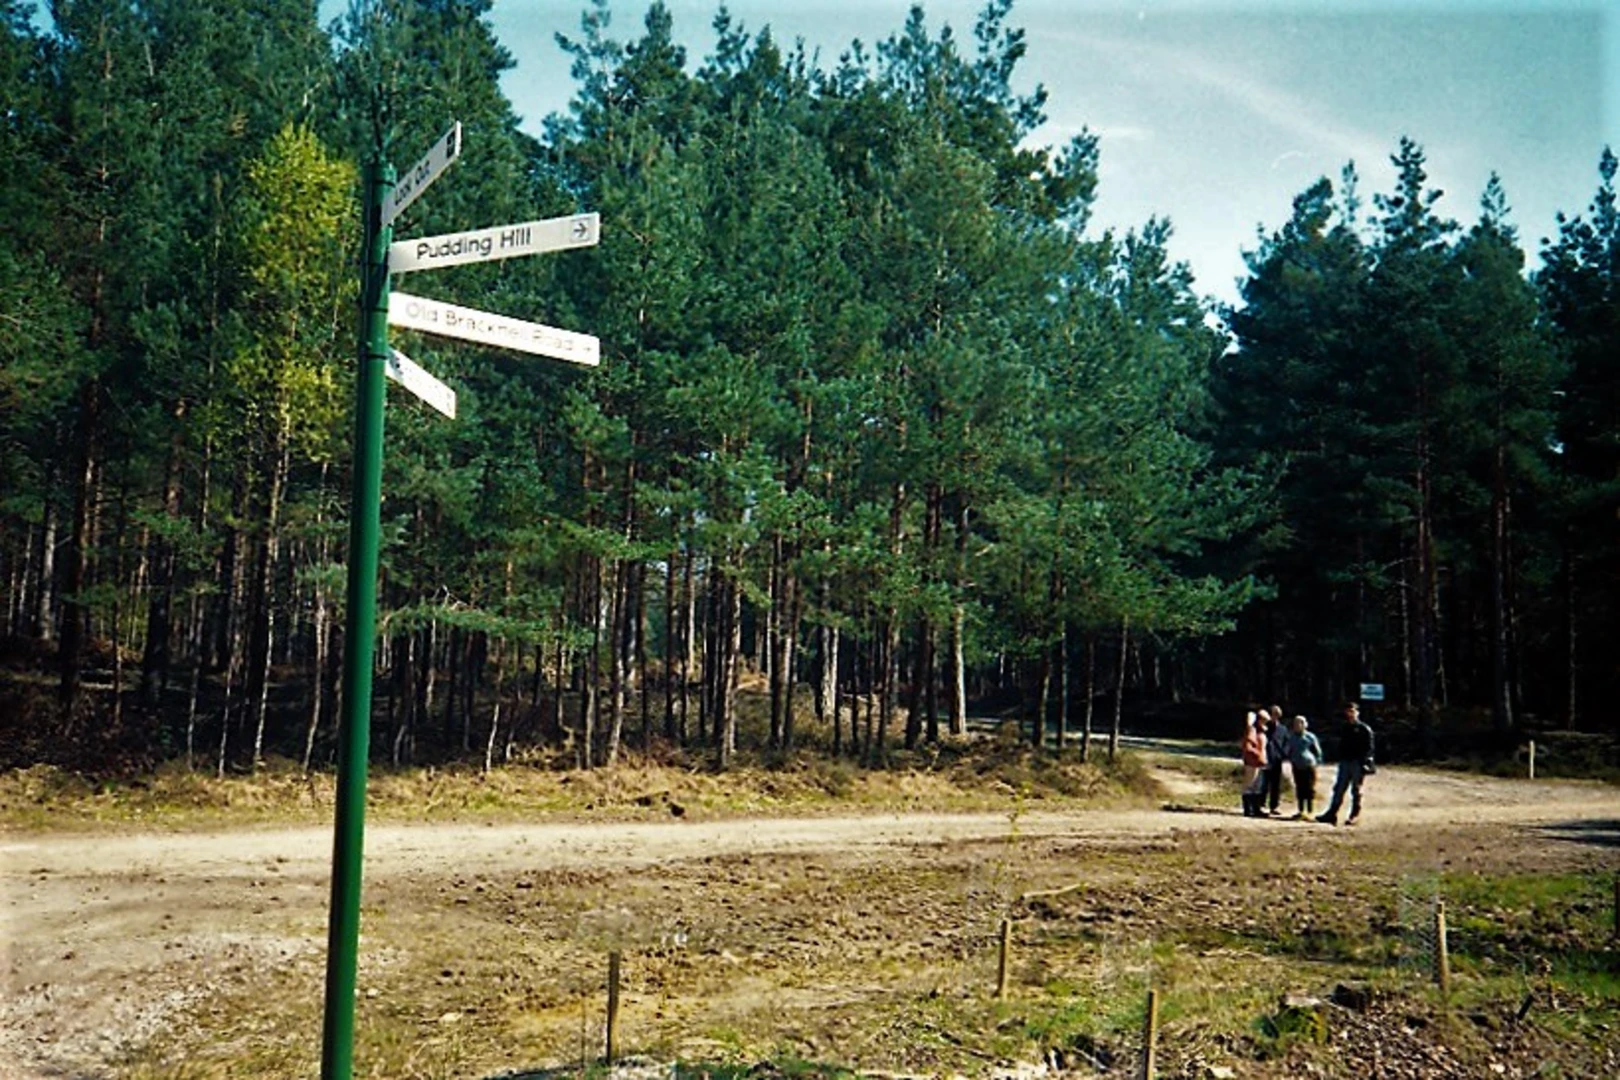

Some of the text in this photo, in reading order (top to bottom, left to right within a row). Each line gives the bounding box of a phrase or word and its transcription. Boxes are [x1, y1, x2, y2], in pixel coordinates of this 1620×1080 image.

[416, 227, 531, 260] Pudding Hill
[405, 301, 439, 322] Old
